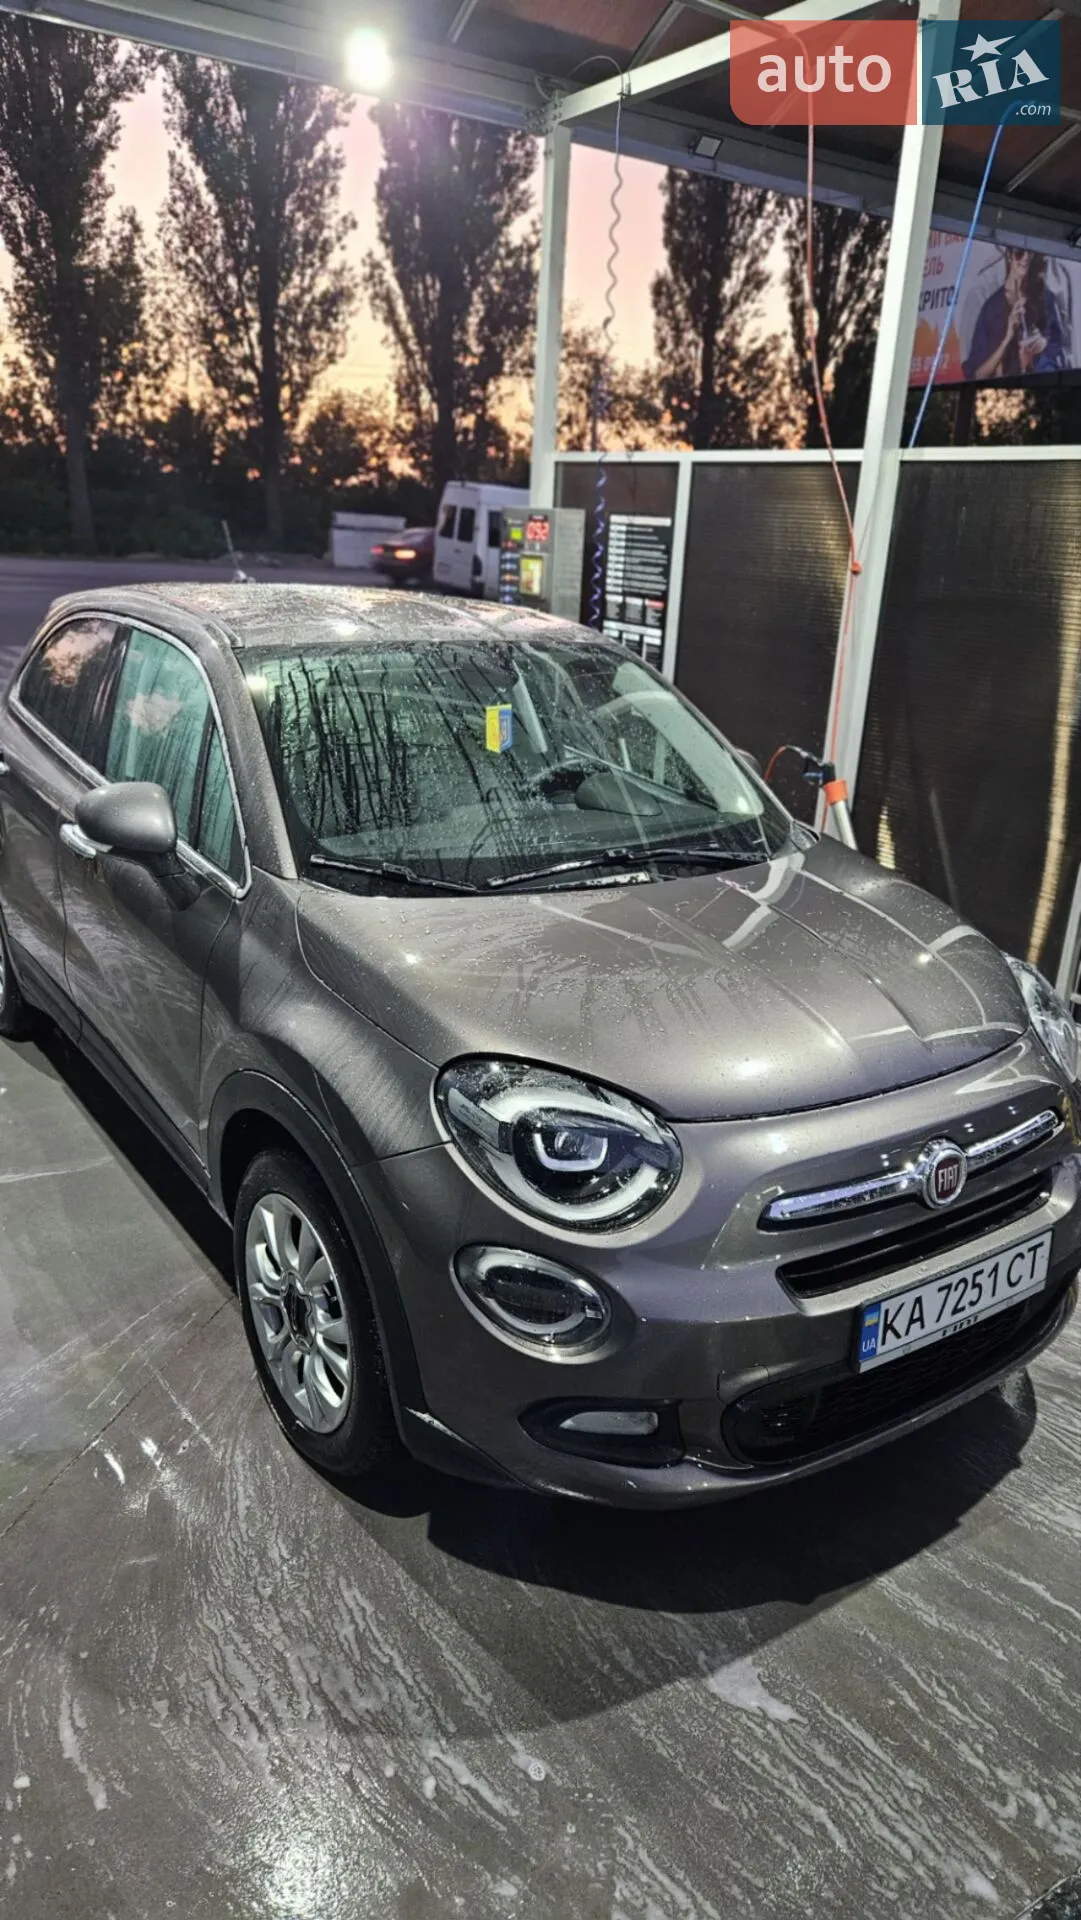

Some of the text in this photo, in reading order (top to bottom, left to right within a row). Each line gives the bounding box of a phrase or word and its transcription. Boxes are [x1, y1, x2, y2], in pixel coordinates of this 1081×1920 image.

[937, 1164, 960, 1192] FIAT
[880, 1296, 925, 1347] KA
[936, 1262, 999, 1323] 7251
[1006, 1241, 1044, 1289] CT
[862, 1339, 877, 1353] UA
